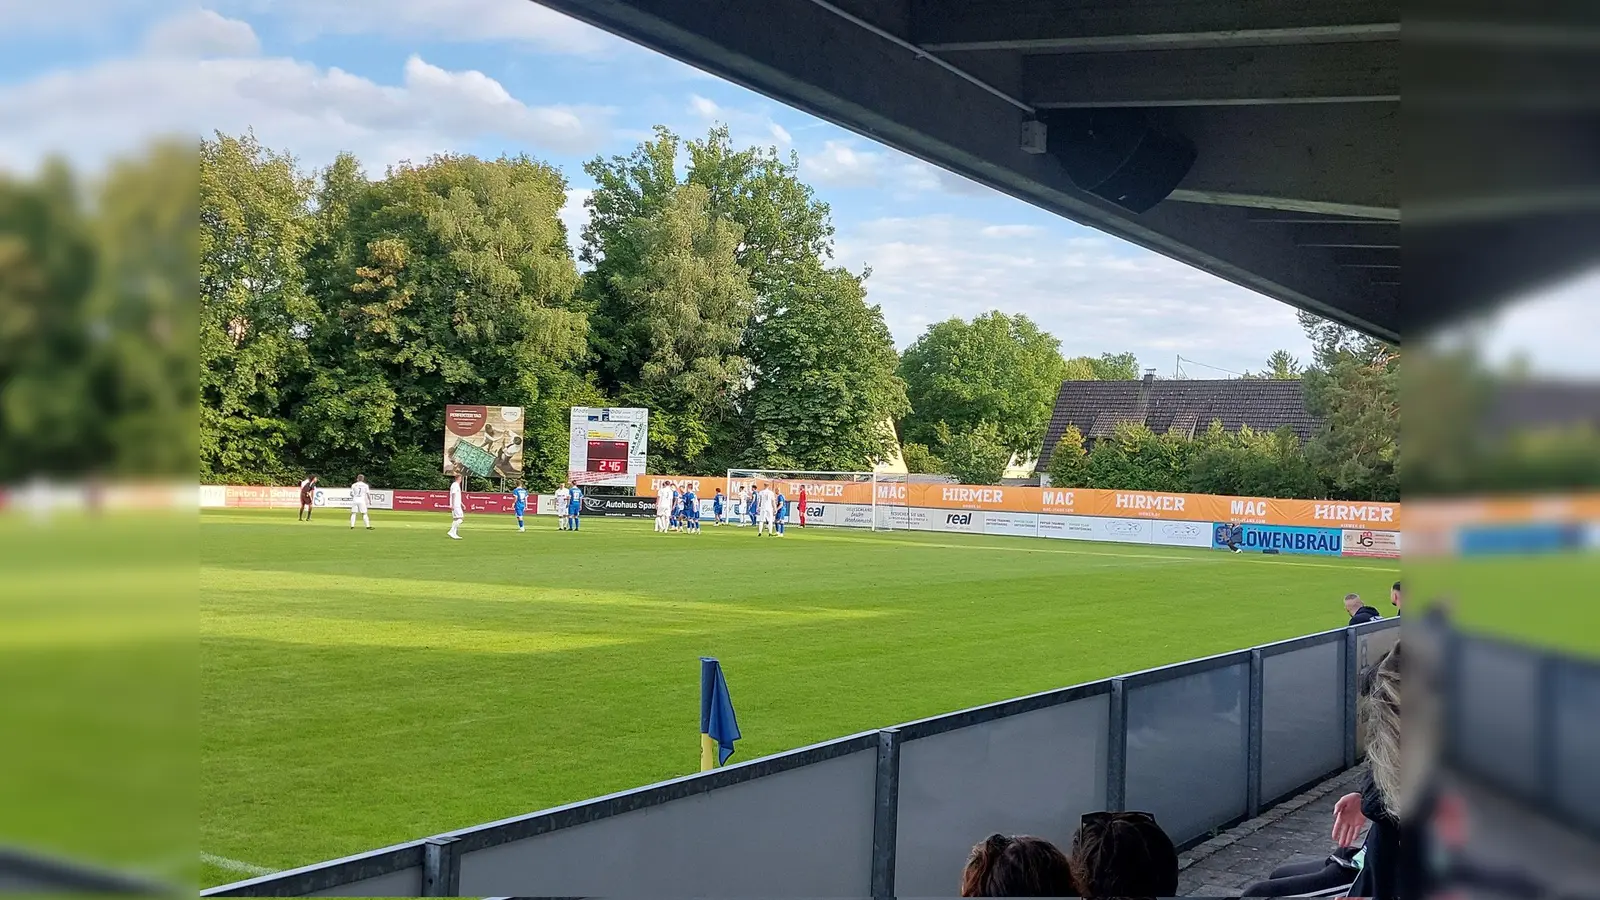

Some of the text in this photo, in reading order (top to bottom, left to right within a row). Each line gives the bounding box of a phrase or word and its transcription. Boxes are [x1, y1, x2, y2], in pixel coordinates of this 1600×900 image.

[877, 485, 906, 499] MAC
[942, 487, 1004, 503] HIRMER
[1042, 491, 1074, 506] MAC
[605, 500, 638, 509] Autohaus
[1115, 493, 1186, 511] HIRMER
[1230, 500, 1267, 516] MAC
[946, 513, 972, 525] real
[1314, 503, 1393, 522] HIRMER
[1240, 527, 1341, 551] ÖWENBRÄU
